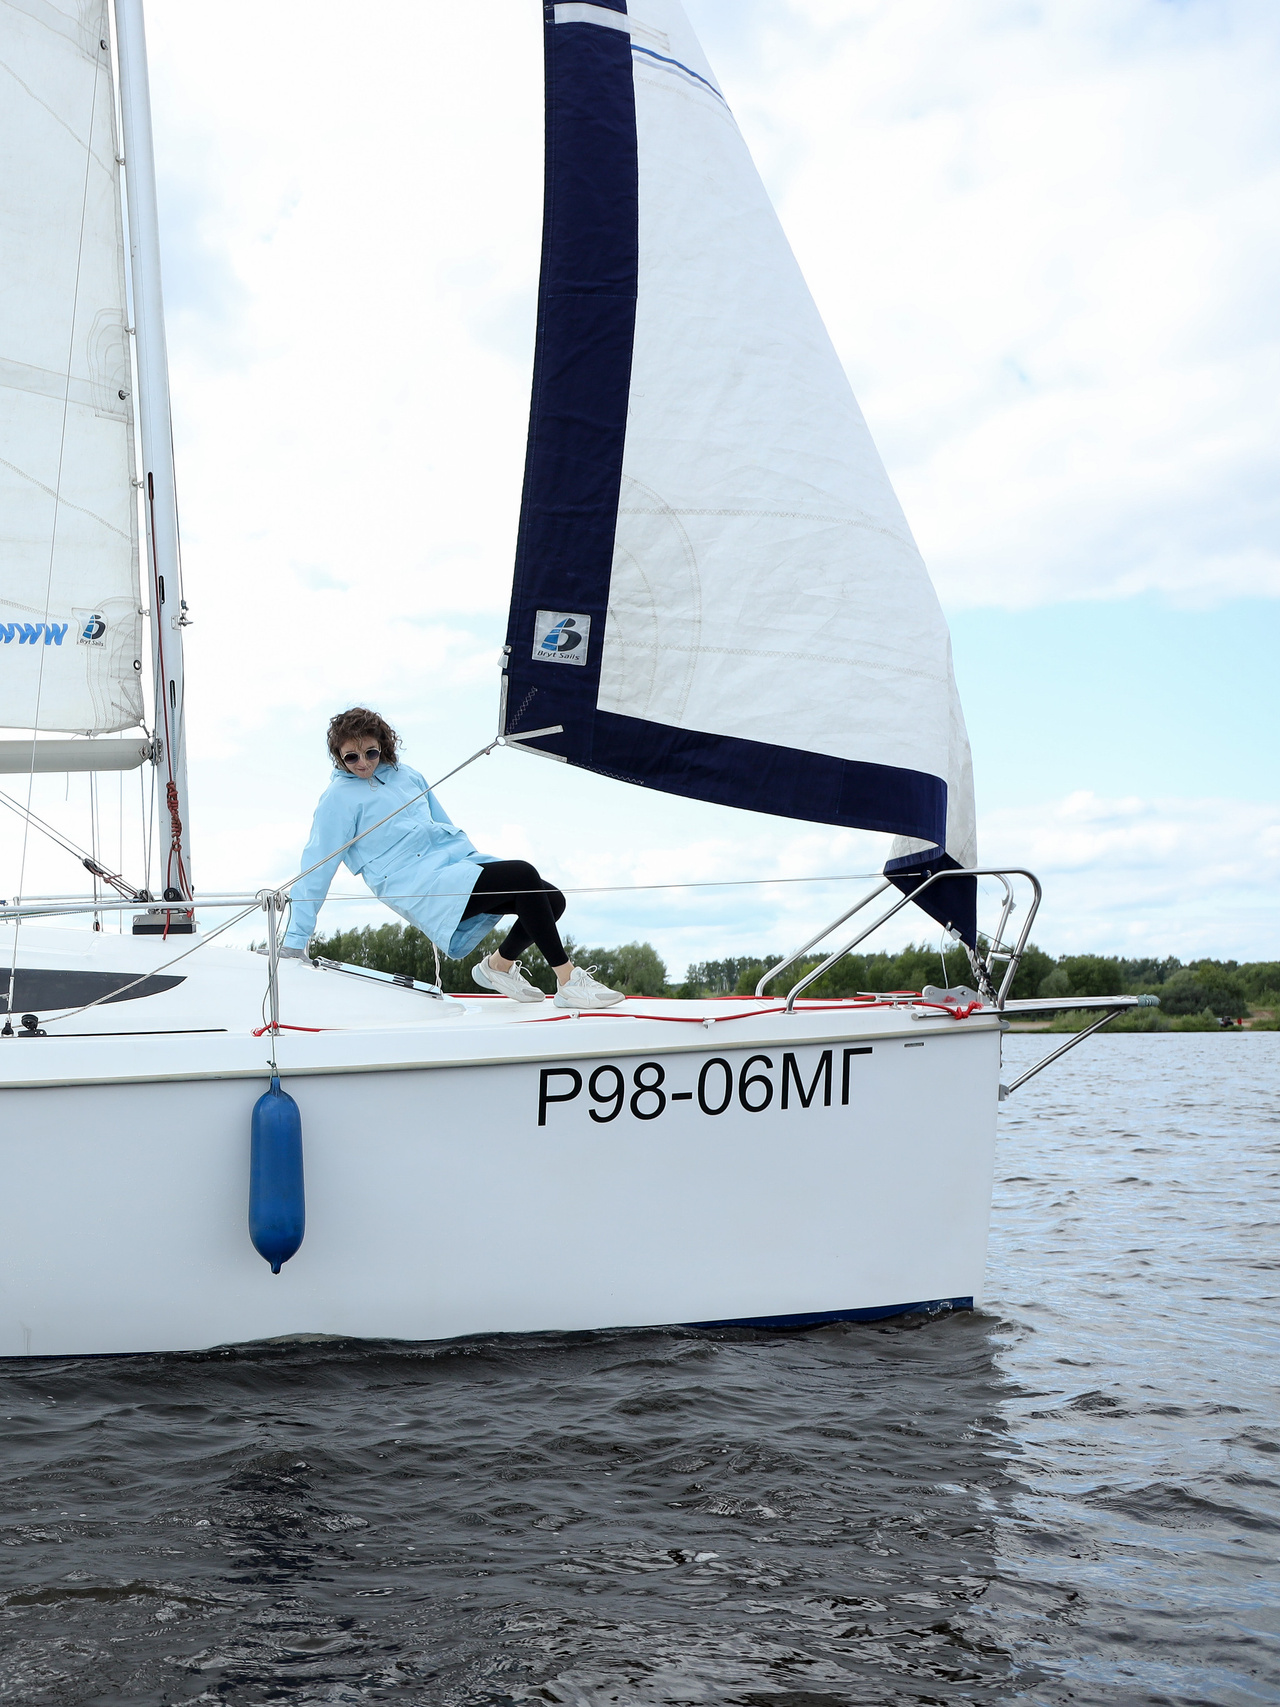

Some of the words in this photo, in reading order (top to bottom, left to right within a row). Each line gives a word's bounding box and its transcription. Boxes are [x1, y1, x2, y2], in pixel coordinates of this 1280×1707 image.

[536, 650, 557, 659] Bryt
[558, 652, 581, 661] Sails
[538, 1046, 873, 1127] Р98-06МГ
